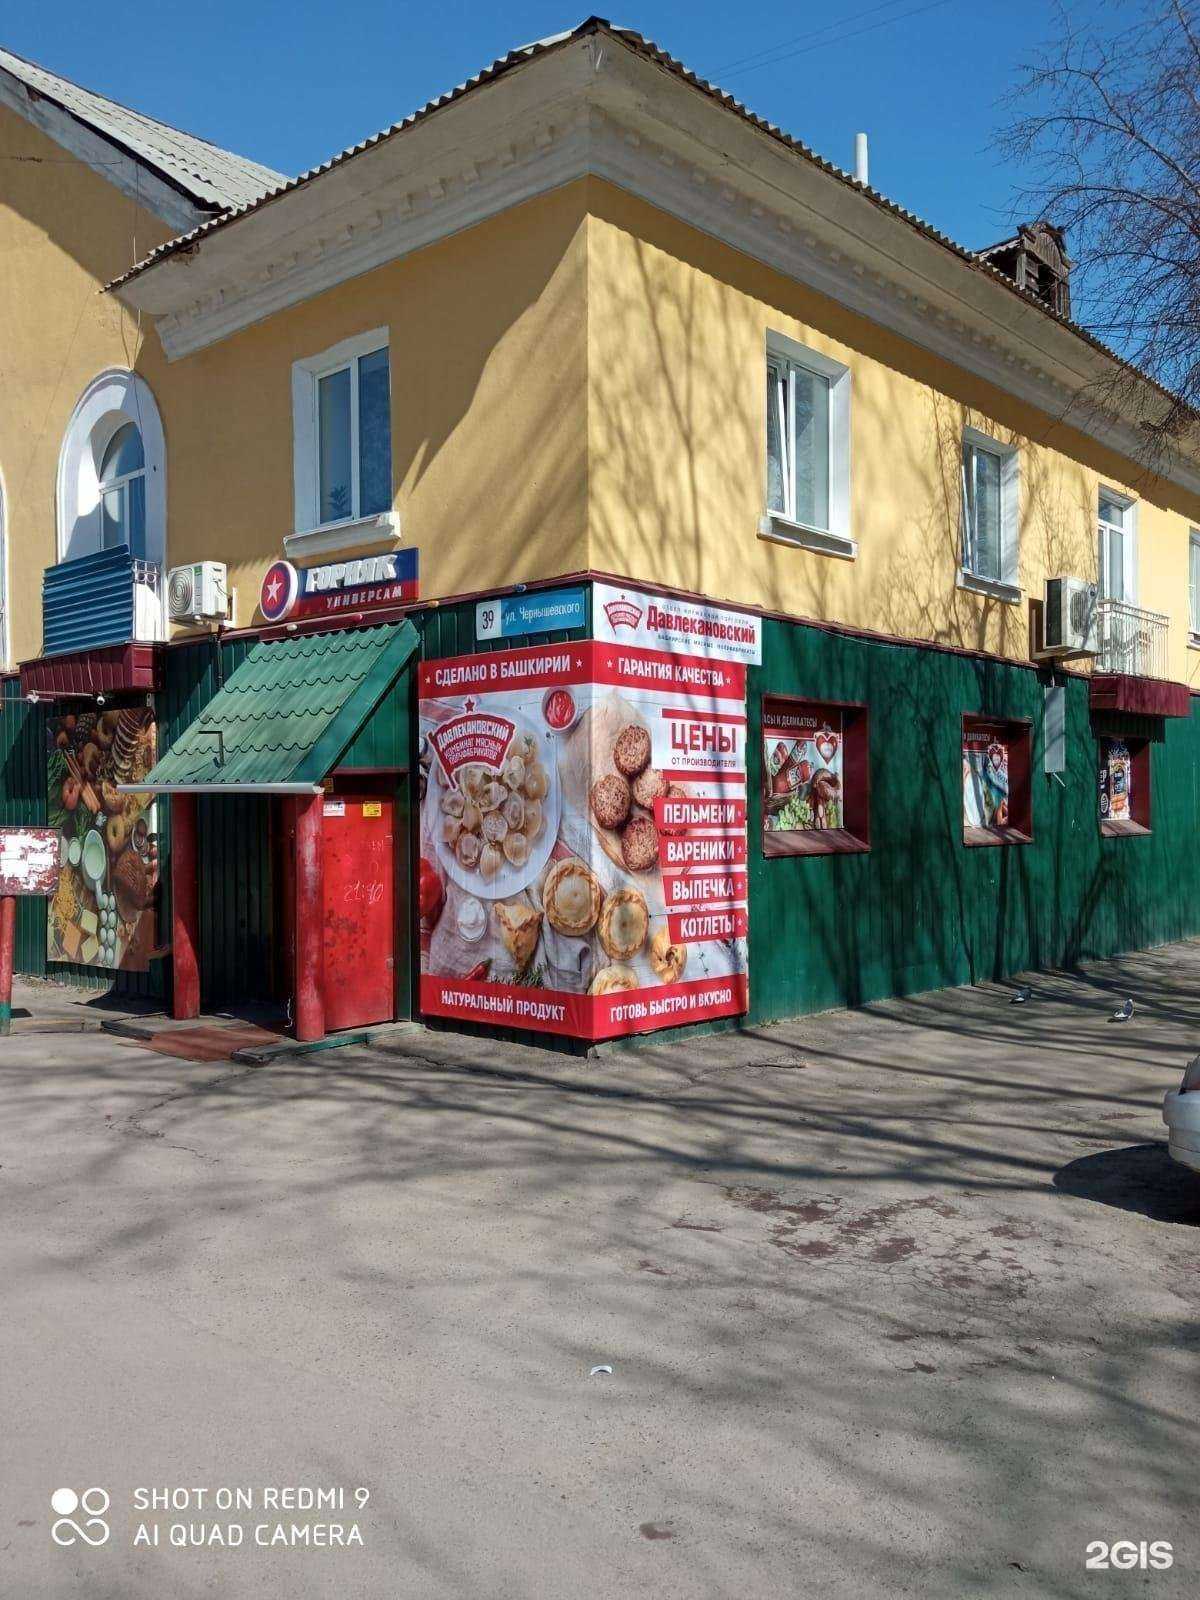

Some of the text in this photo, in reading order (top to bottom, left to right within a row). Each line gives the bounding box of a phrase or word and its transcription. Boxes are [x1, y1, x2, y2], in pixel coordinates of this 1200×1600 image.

[326, 585, 402, 608] УНИВЕРСАМ
[482, 610, 494, 629] 39
[505, 602, 580, 625] ул. Чернышевского
[647, 605, 755, 645] Давлекановский
[435, 655, 571, 686] СДЕЛАНО В БАШКИРИИ
[618, 657, 724, 687] ГАРАНТИЯ КАЧЕСТВА
[437, 720, 509, 750] ДАВЛЕКАНОВСКИЙ
[672, 723, 736, 755] ЦЕНЫ
[672, 757, 737, 768] ОТ ПРОИЗВОДИТЕЛЯ
[663, 804, 735, 824] ПЕЛЬМЕНИ
[667, 841, 735, 862] ВАРЕНИКИ
[672, 878, 735, 901] ВЫПЕЧКА
[680, 914, 735, 938] КОТЛЕТЫ
[441, 990, 565, 1021] НАТУРАЛЬНЫЙ ПРОДУКТ
[610, 989, 732, 1023] ГОТОВЬ БЫСТРО И ВКУСНО
